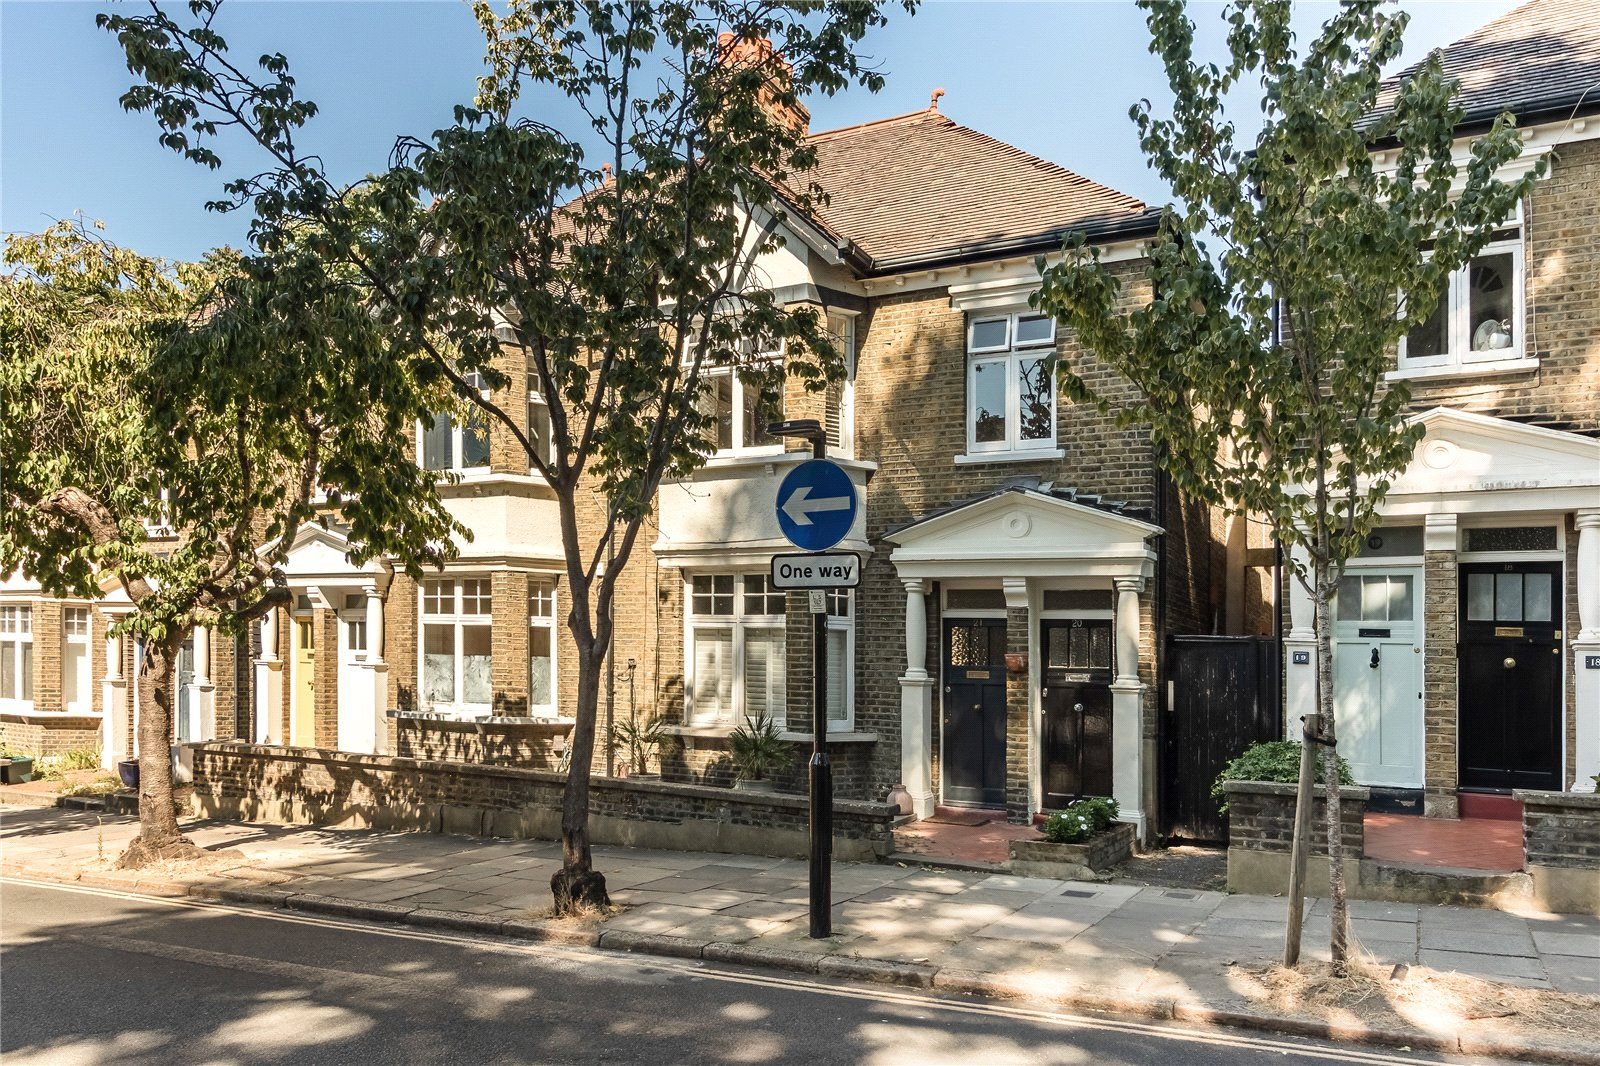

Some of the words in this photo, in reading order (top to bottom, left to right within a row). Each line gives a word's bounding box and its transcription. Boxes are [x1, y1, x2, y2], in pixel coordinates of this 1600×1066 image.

[780, 563, 813, 579] One
[818, 565, 853, 580] way
[973, 619, 983, 627] 21
[1071, 619, 1083, 628] 20
[1591, 658, 1600, 666] 18
